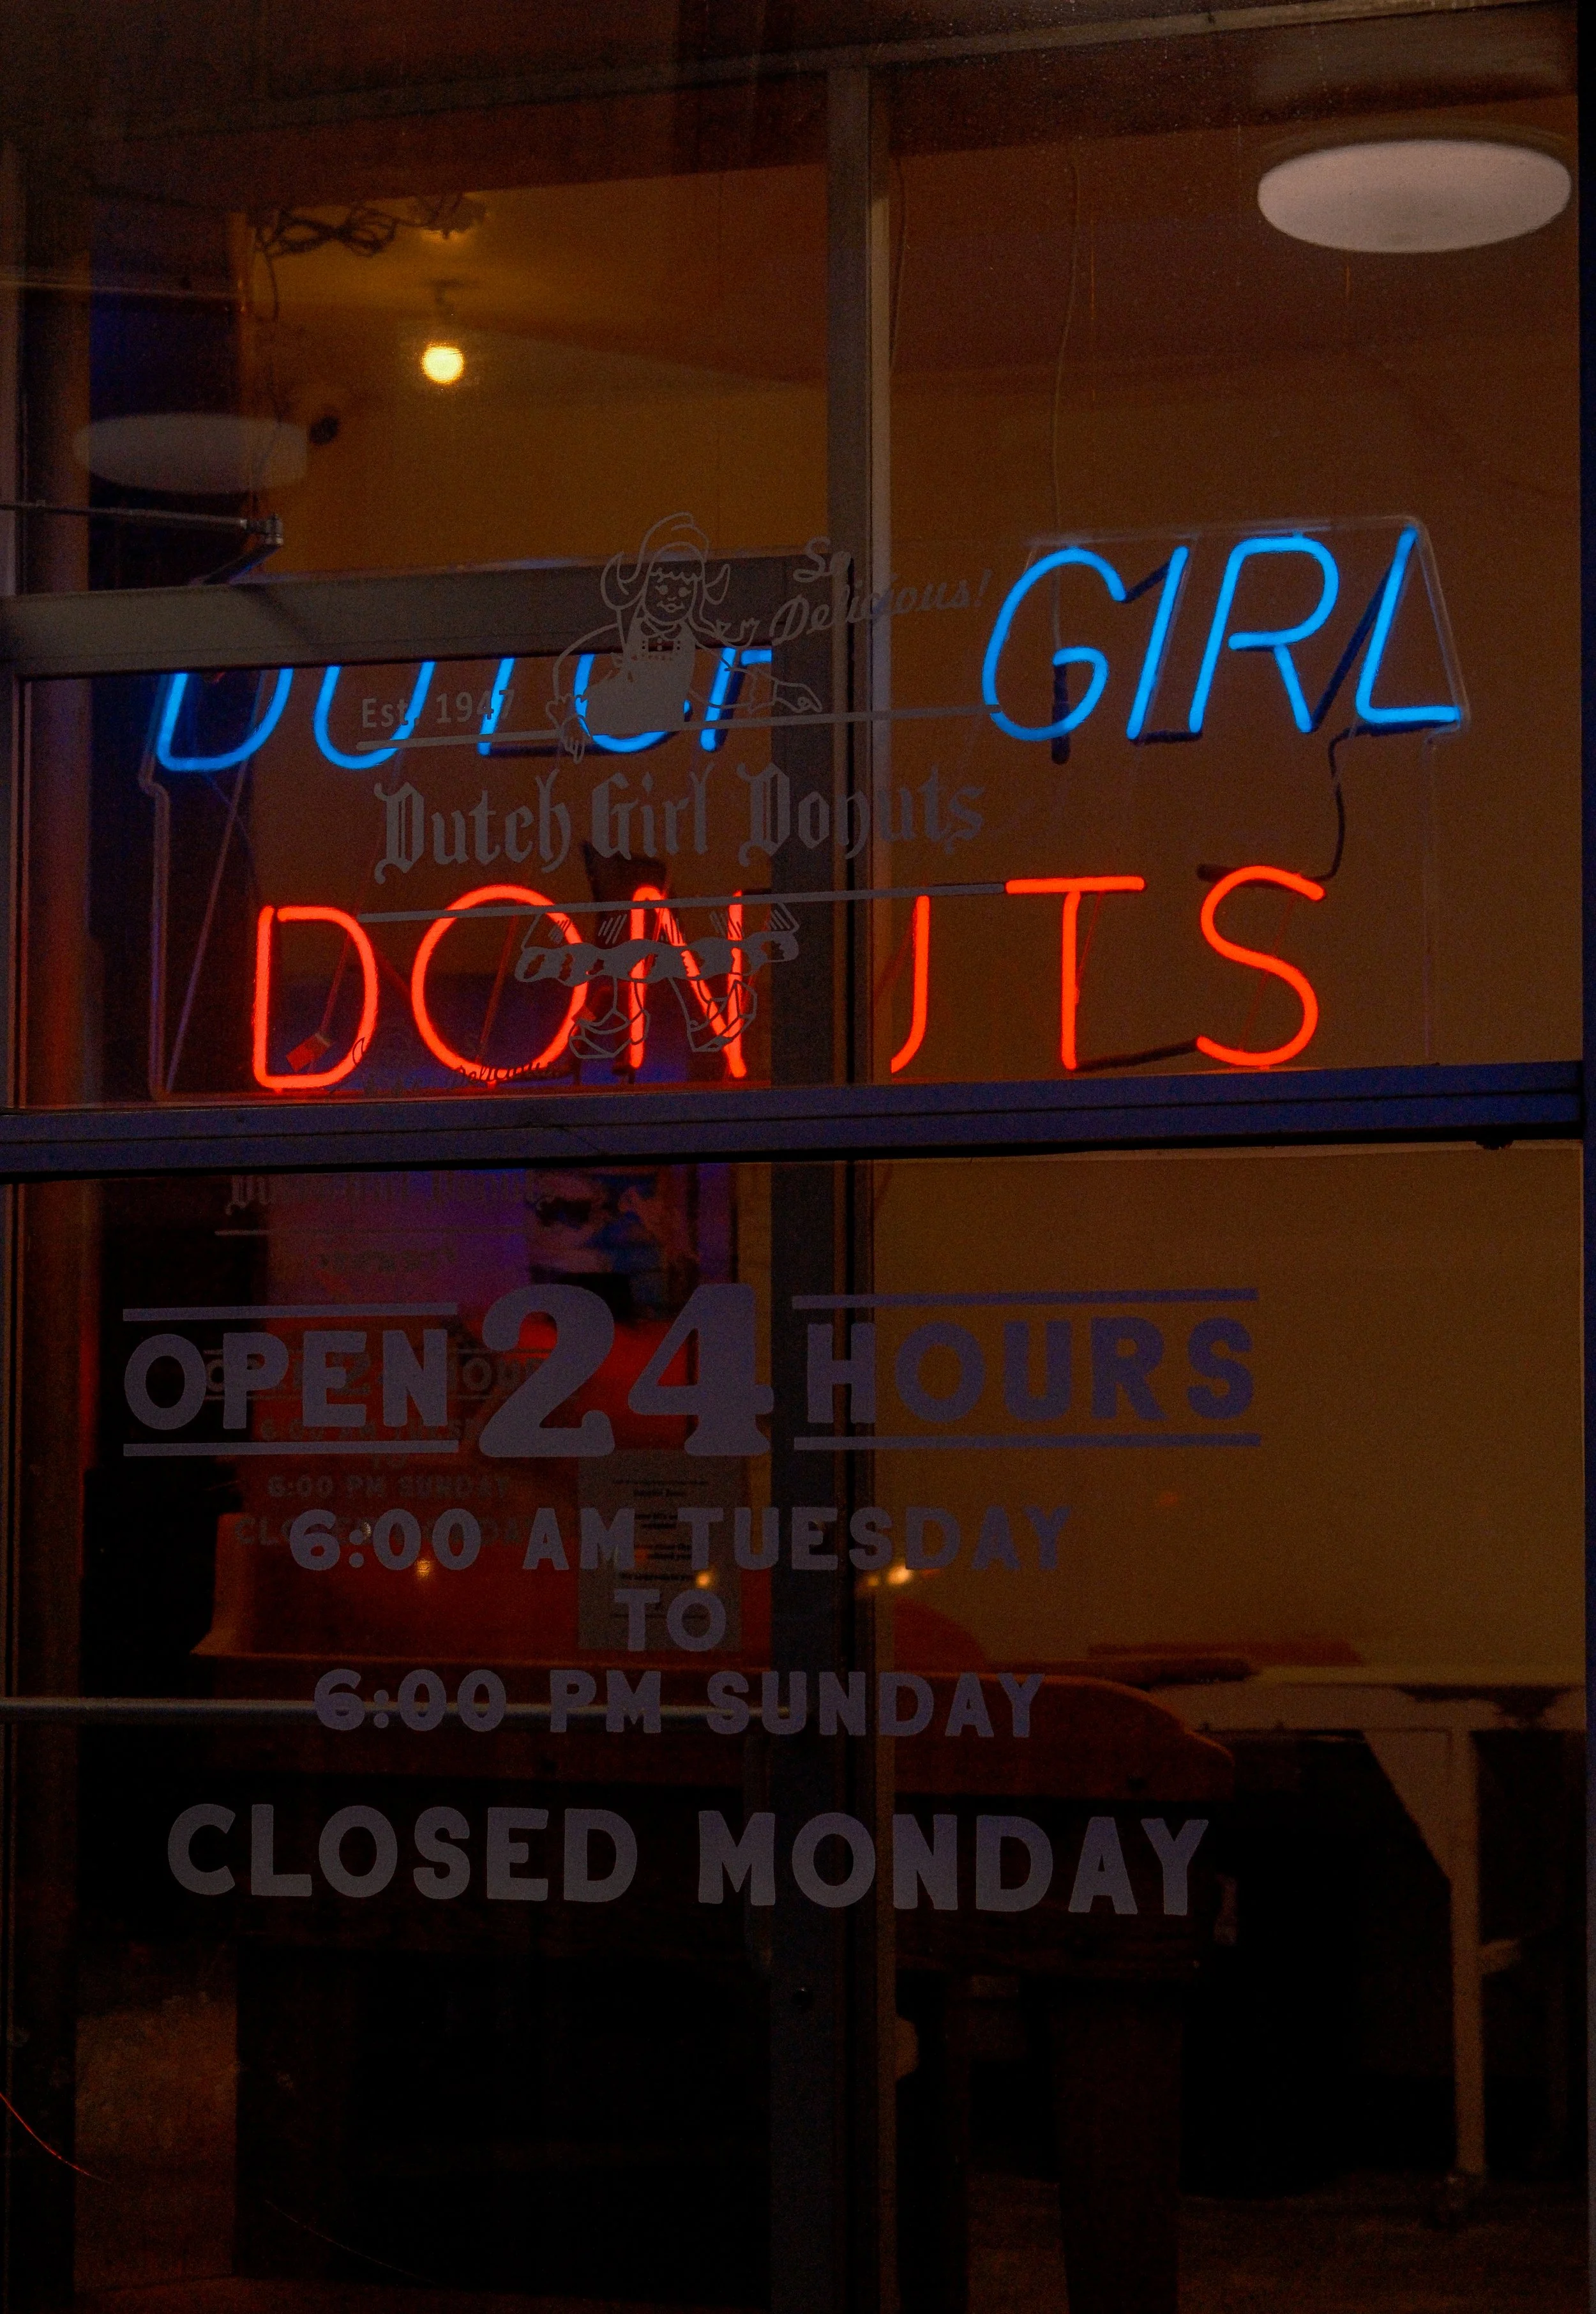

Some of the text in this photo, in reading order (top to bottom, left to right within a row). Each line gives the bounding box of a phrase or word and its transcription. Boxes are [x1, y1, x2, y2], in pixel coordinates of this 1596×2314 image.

[792, 535, 853, 584] So
[768, 568, 993, 647] Delicious!
[981, 525, 1462, 743] GIRL
[431, 689, 516, 724] 1947
[373, 762, 986, 885] Dutch Girl Donuts
[124, 1283, 1256, 1458] OPEN 24 HOURS
[289, 1508, 482, 1571] 6:00
[523, 1508, 636, 1571] AM
[677, 1504, 1072, 1572] TUESDAY
[614, 1589, 727, 1652] TO
[314, 1669, 1045, 1738] 6:00 PM SUNDAY
[167, 1804, 1210, 1916] CLOSED MONDAY
